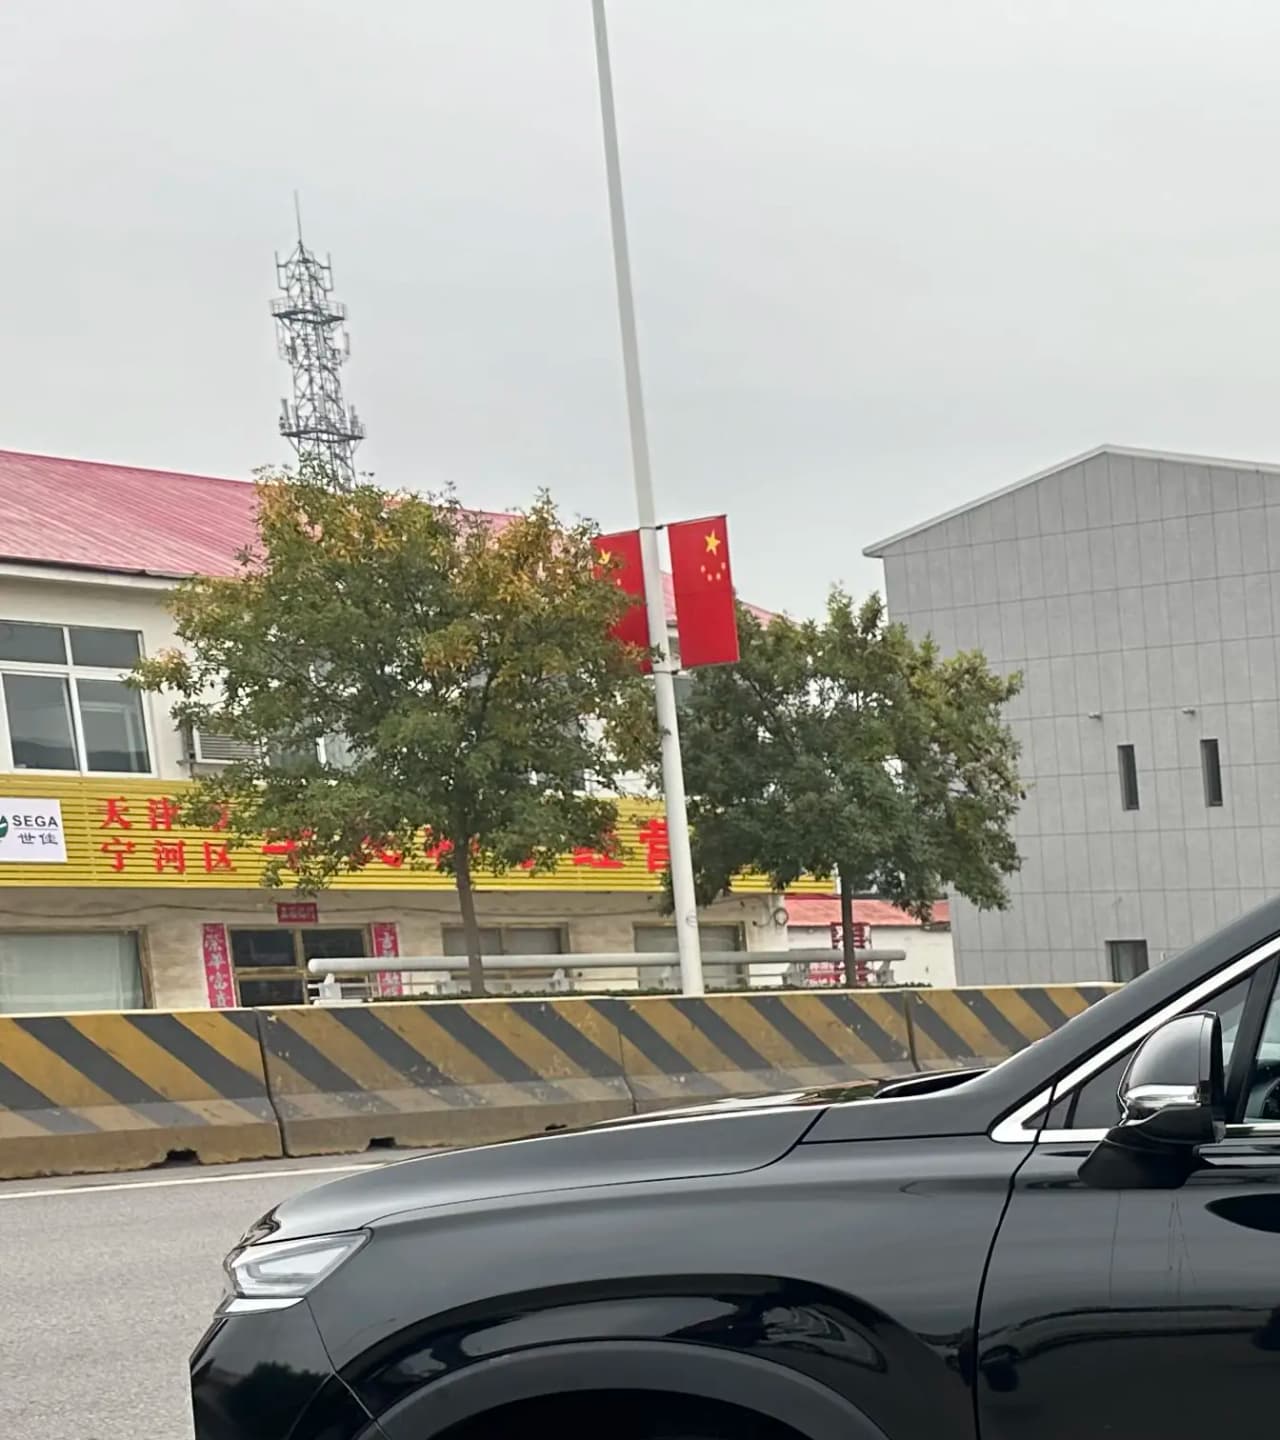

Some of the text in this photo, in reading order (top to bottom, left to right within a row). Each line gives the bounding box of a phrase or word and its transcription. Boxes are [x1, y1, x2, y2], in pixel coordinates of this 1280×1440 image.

[12, 814, 58, 827] SEGA
[99, 838, 237, 873] 宁河区
